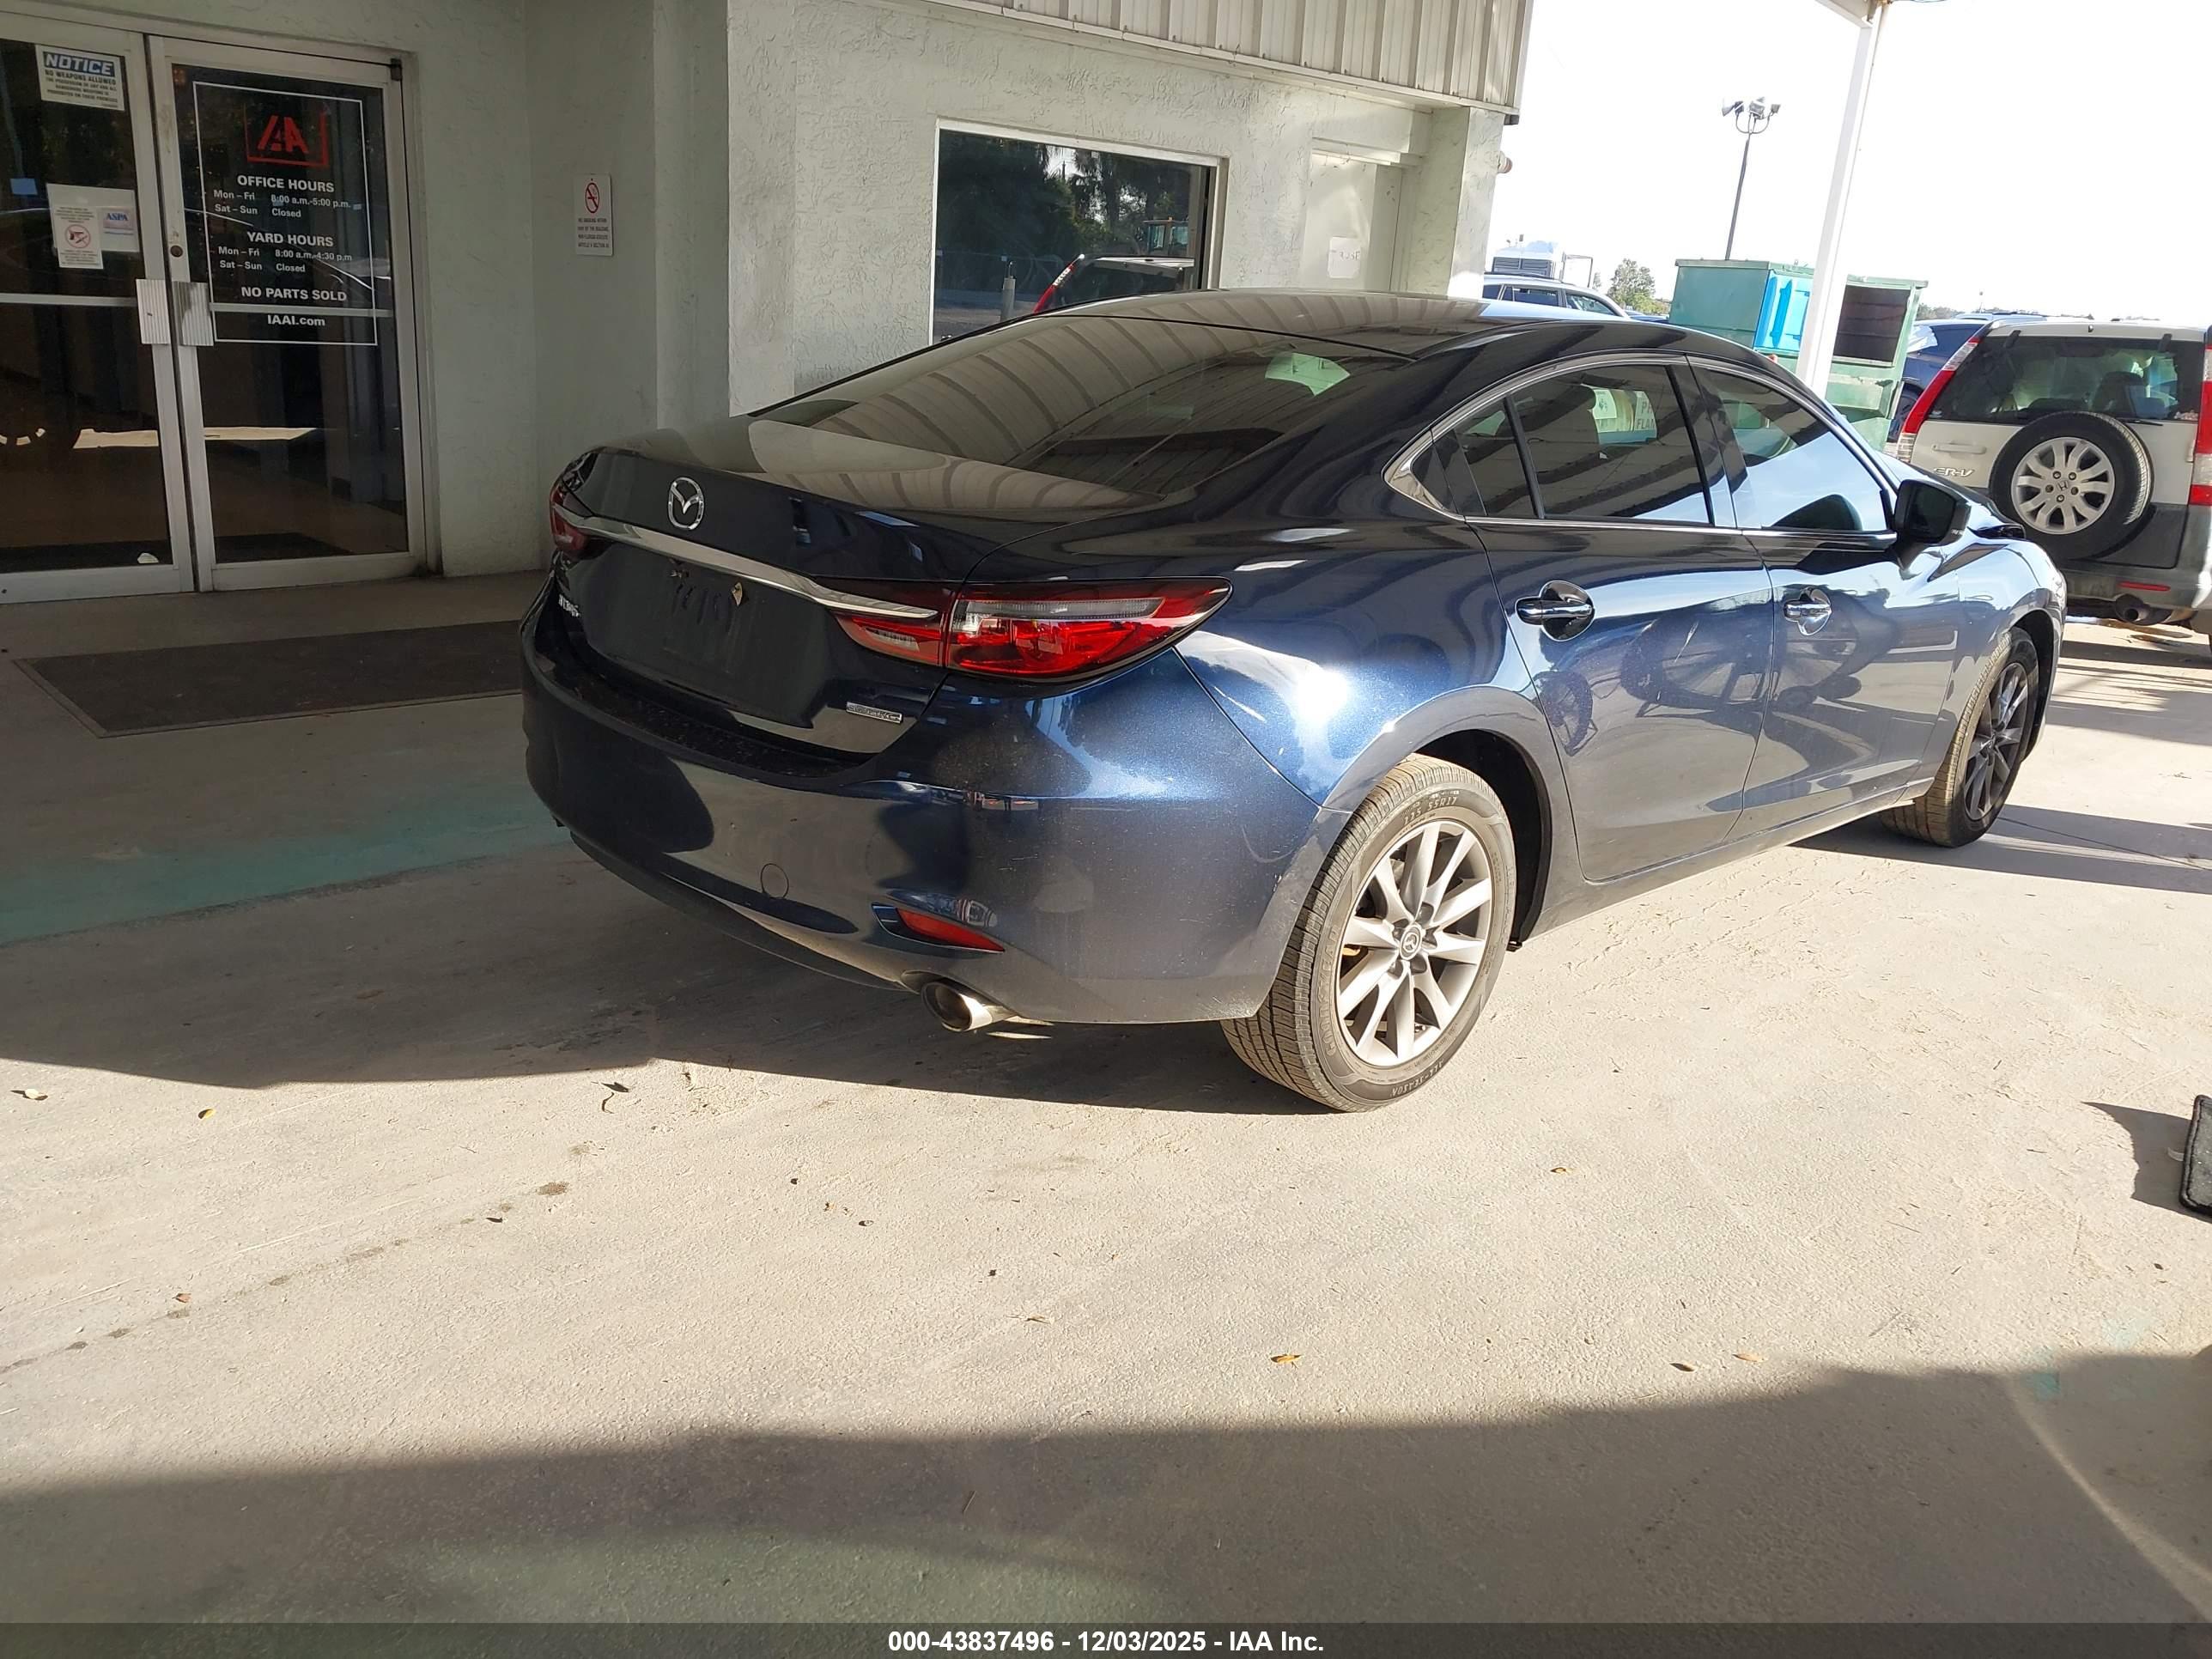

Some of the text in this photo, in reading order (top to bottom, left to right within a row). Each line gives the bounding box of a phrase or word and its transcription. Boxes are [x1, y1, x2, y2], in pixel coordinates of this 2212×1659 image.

[45, 53, 112, 76] NOTICE
[237, 174, 335, 193] OFFICE HOURS
[213, 189, 234, 199] Mon
[244, 191, 255, 201] Fri
[106, 211, 129, 222] ASPA
[215, 204, 231, 213] Sat
[240, 205, 258, 215] Sun
[271, 207, 302, 218] Closed
[246, 231, 334, 247] YARD HOURS
[218, 246, 240, 256] Mon
[248, 248, 260, 258] Fri
[275, 249, 294, 258] 8:00
[219, 260, 235, 269] Sat
[245, 261, 263, 270] Sun
[276, 263, 306, 273] Closed
[241, 287, 347, 301] NO PARTS SOLD
[267, 314, 325, 326] IAAI.com
[1933, 467, 1975, 477] CR-V
